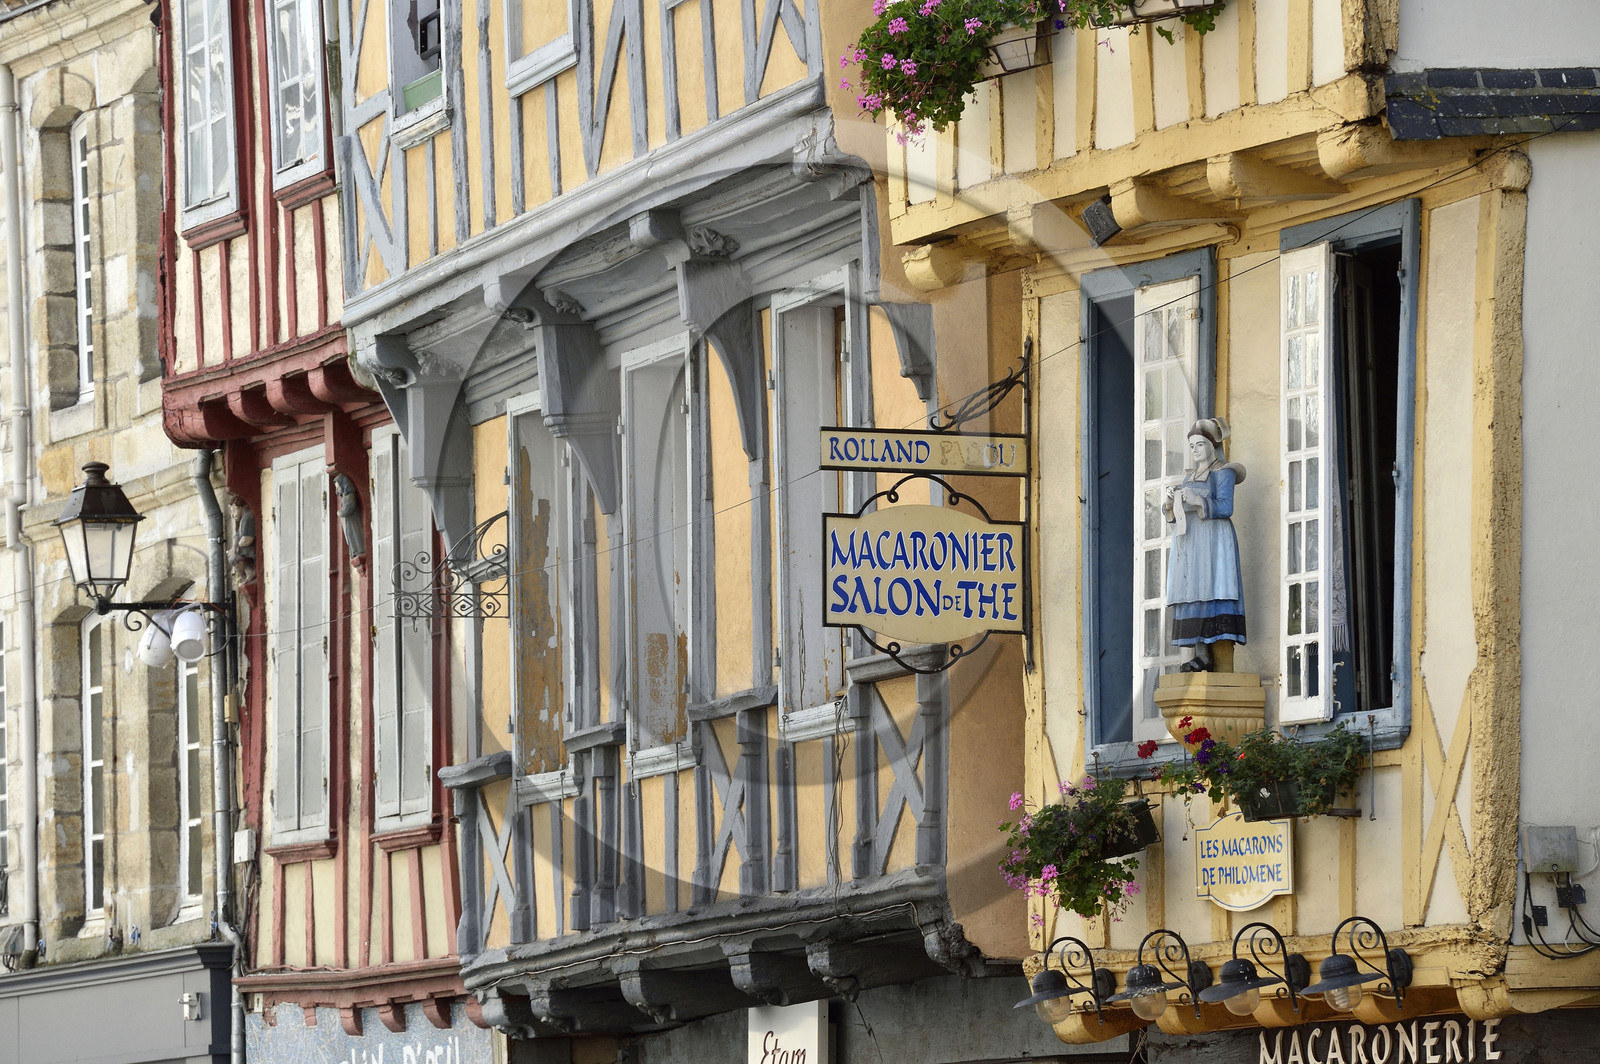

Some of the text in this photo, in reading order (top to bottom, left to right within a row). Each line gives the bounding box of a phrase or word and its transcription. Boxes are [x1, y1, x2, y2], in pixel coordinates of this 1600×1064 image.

[829, 437, 931, 464] ROLLAND
[830, 527, 1017, 575] MACARONIER
[830, 574, 1018, 621] SALON DE THE
[1200, 834, 1283, 859] LES MACARONS
[1202, 863, 1283, 886] DE PHILOMENE
[1258, 1018, 1503, 1064] MACARONERIE
